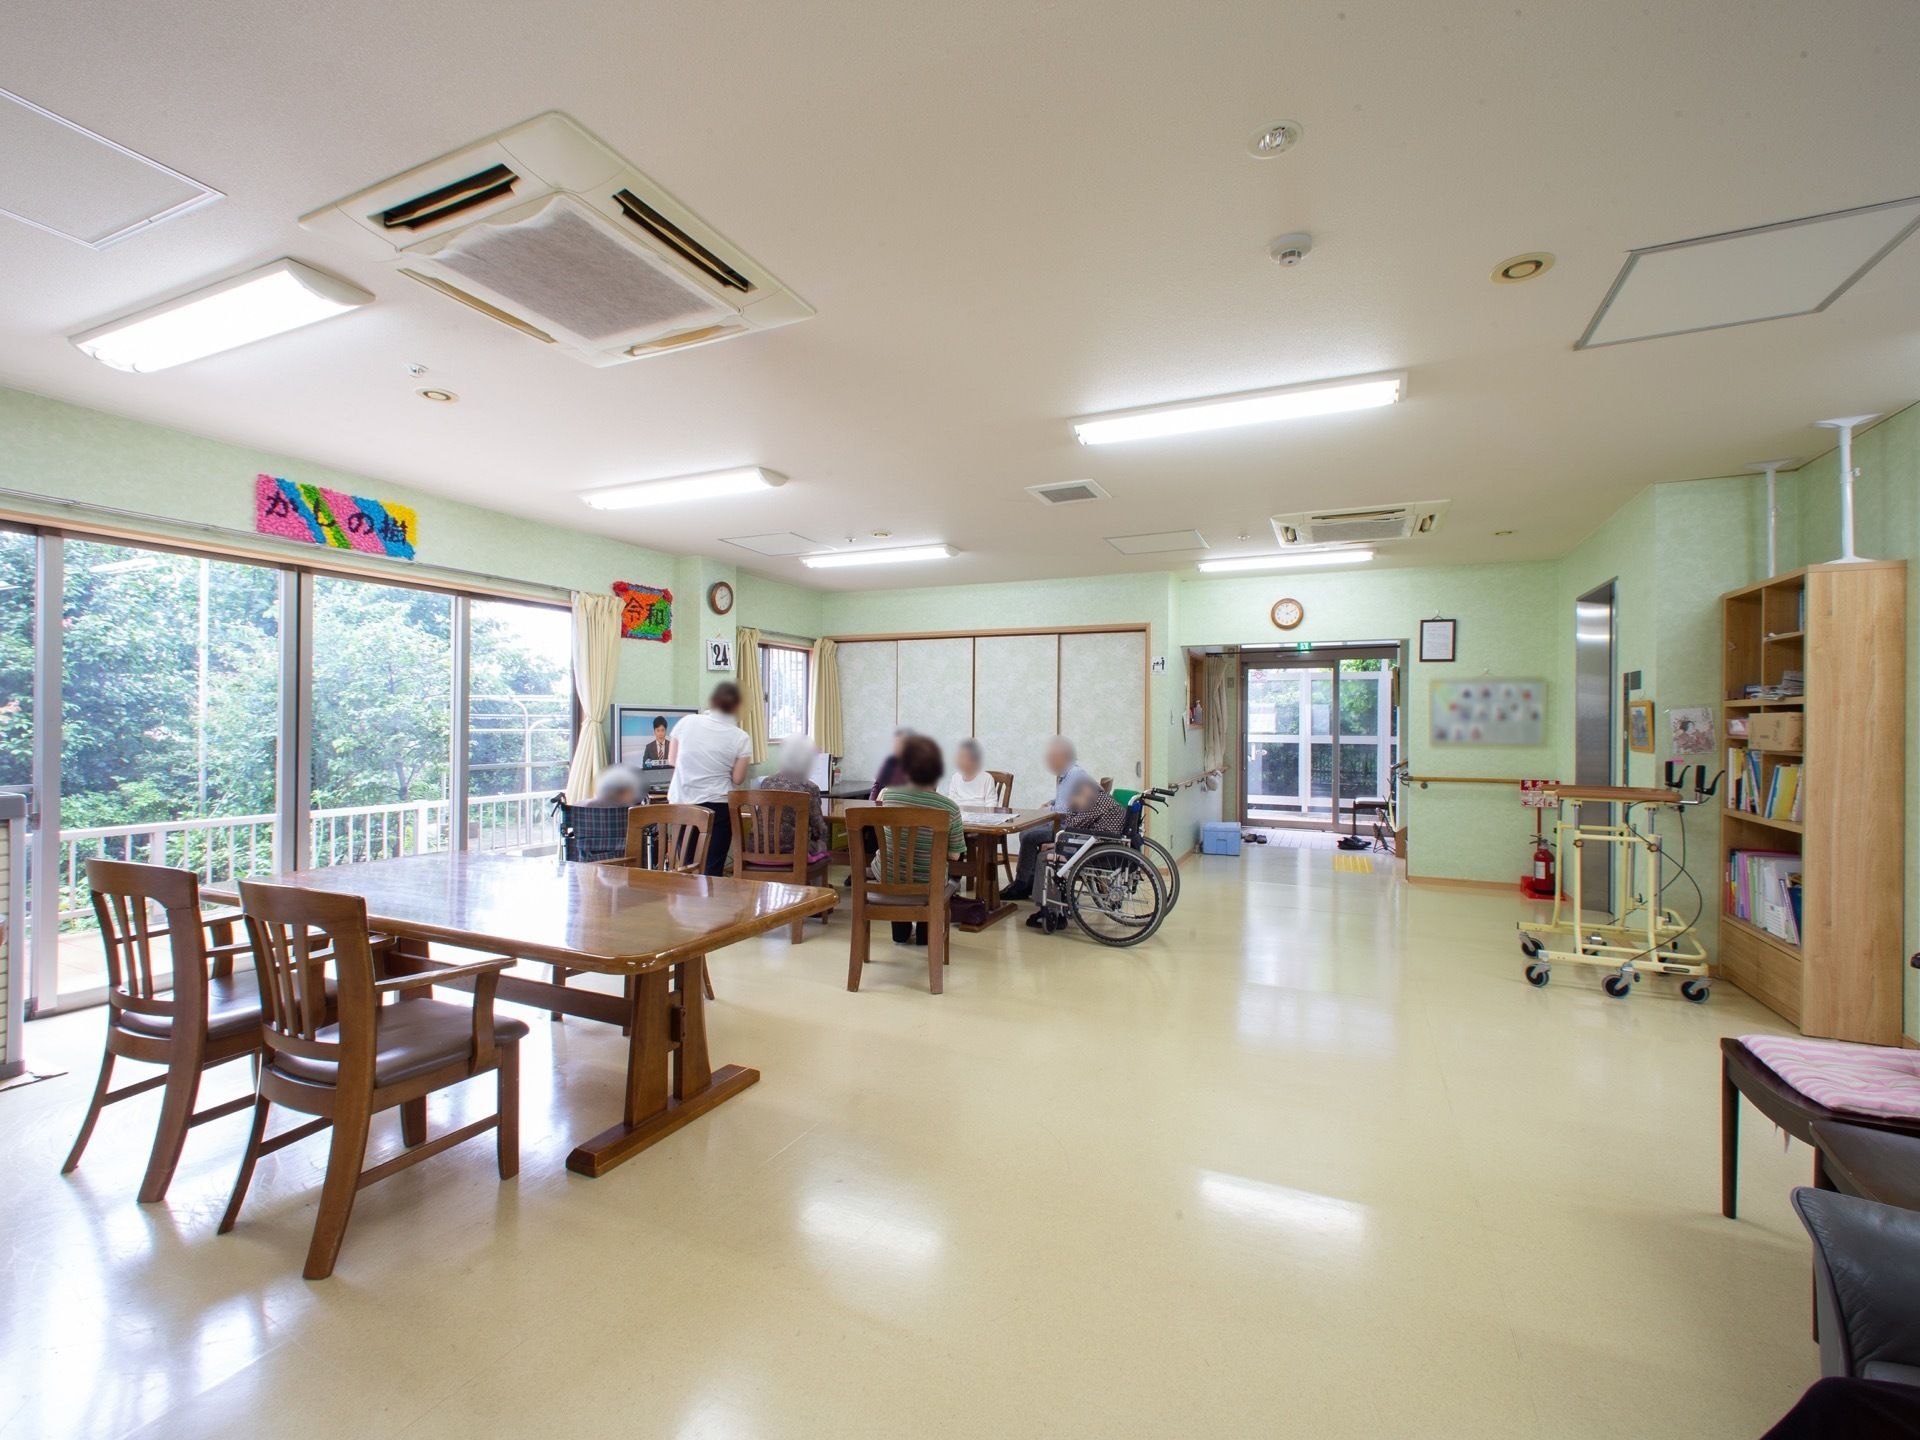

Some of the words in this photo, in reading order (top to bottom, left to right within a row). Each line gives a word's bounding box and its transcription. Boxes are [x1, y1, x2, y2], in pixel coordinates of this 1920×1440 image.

[265, 490, 408, 545] かしの樹
[624, 596, 665, 627] 令和
[713, 643, 729, 666] 24
